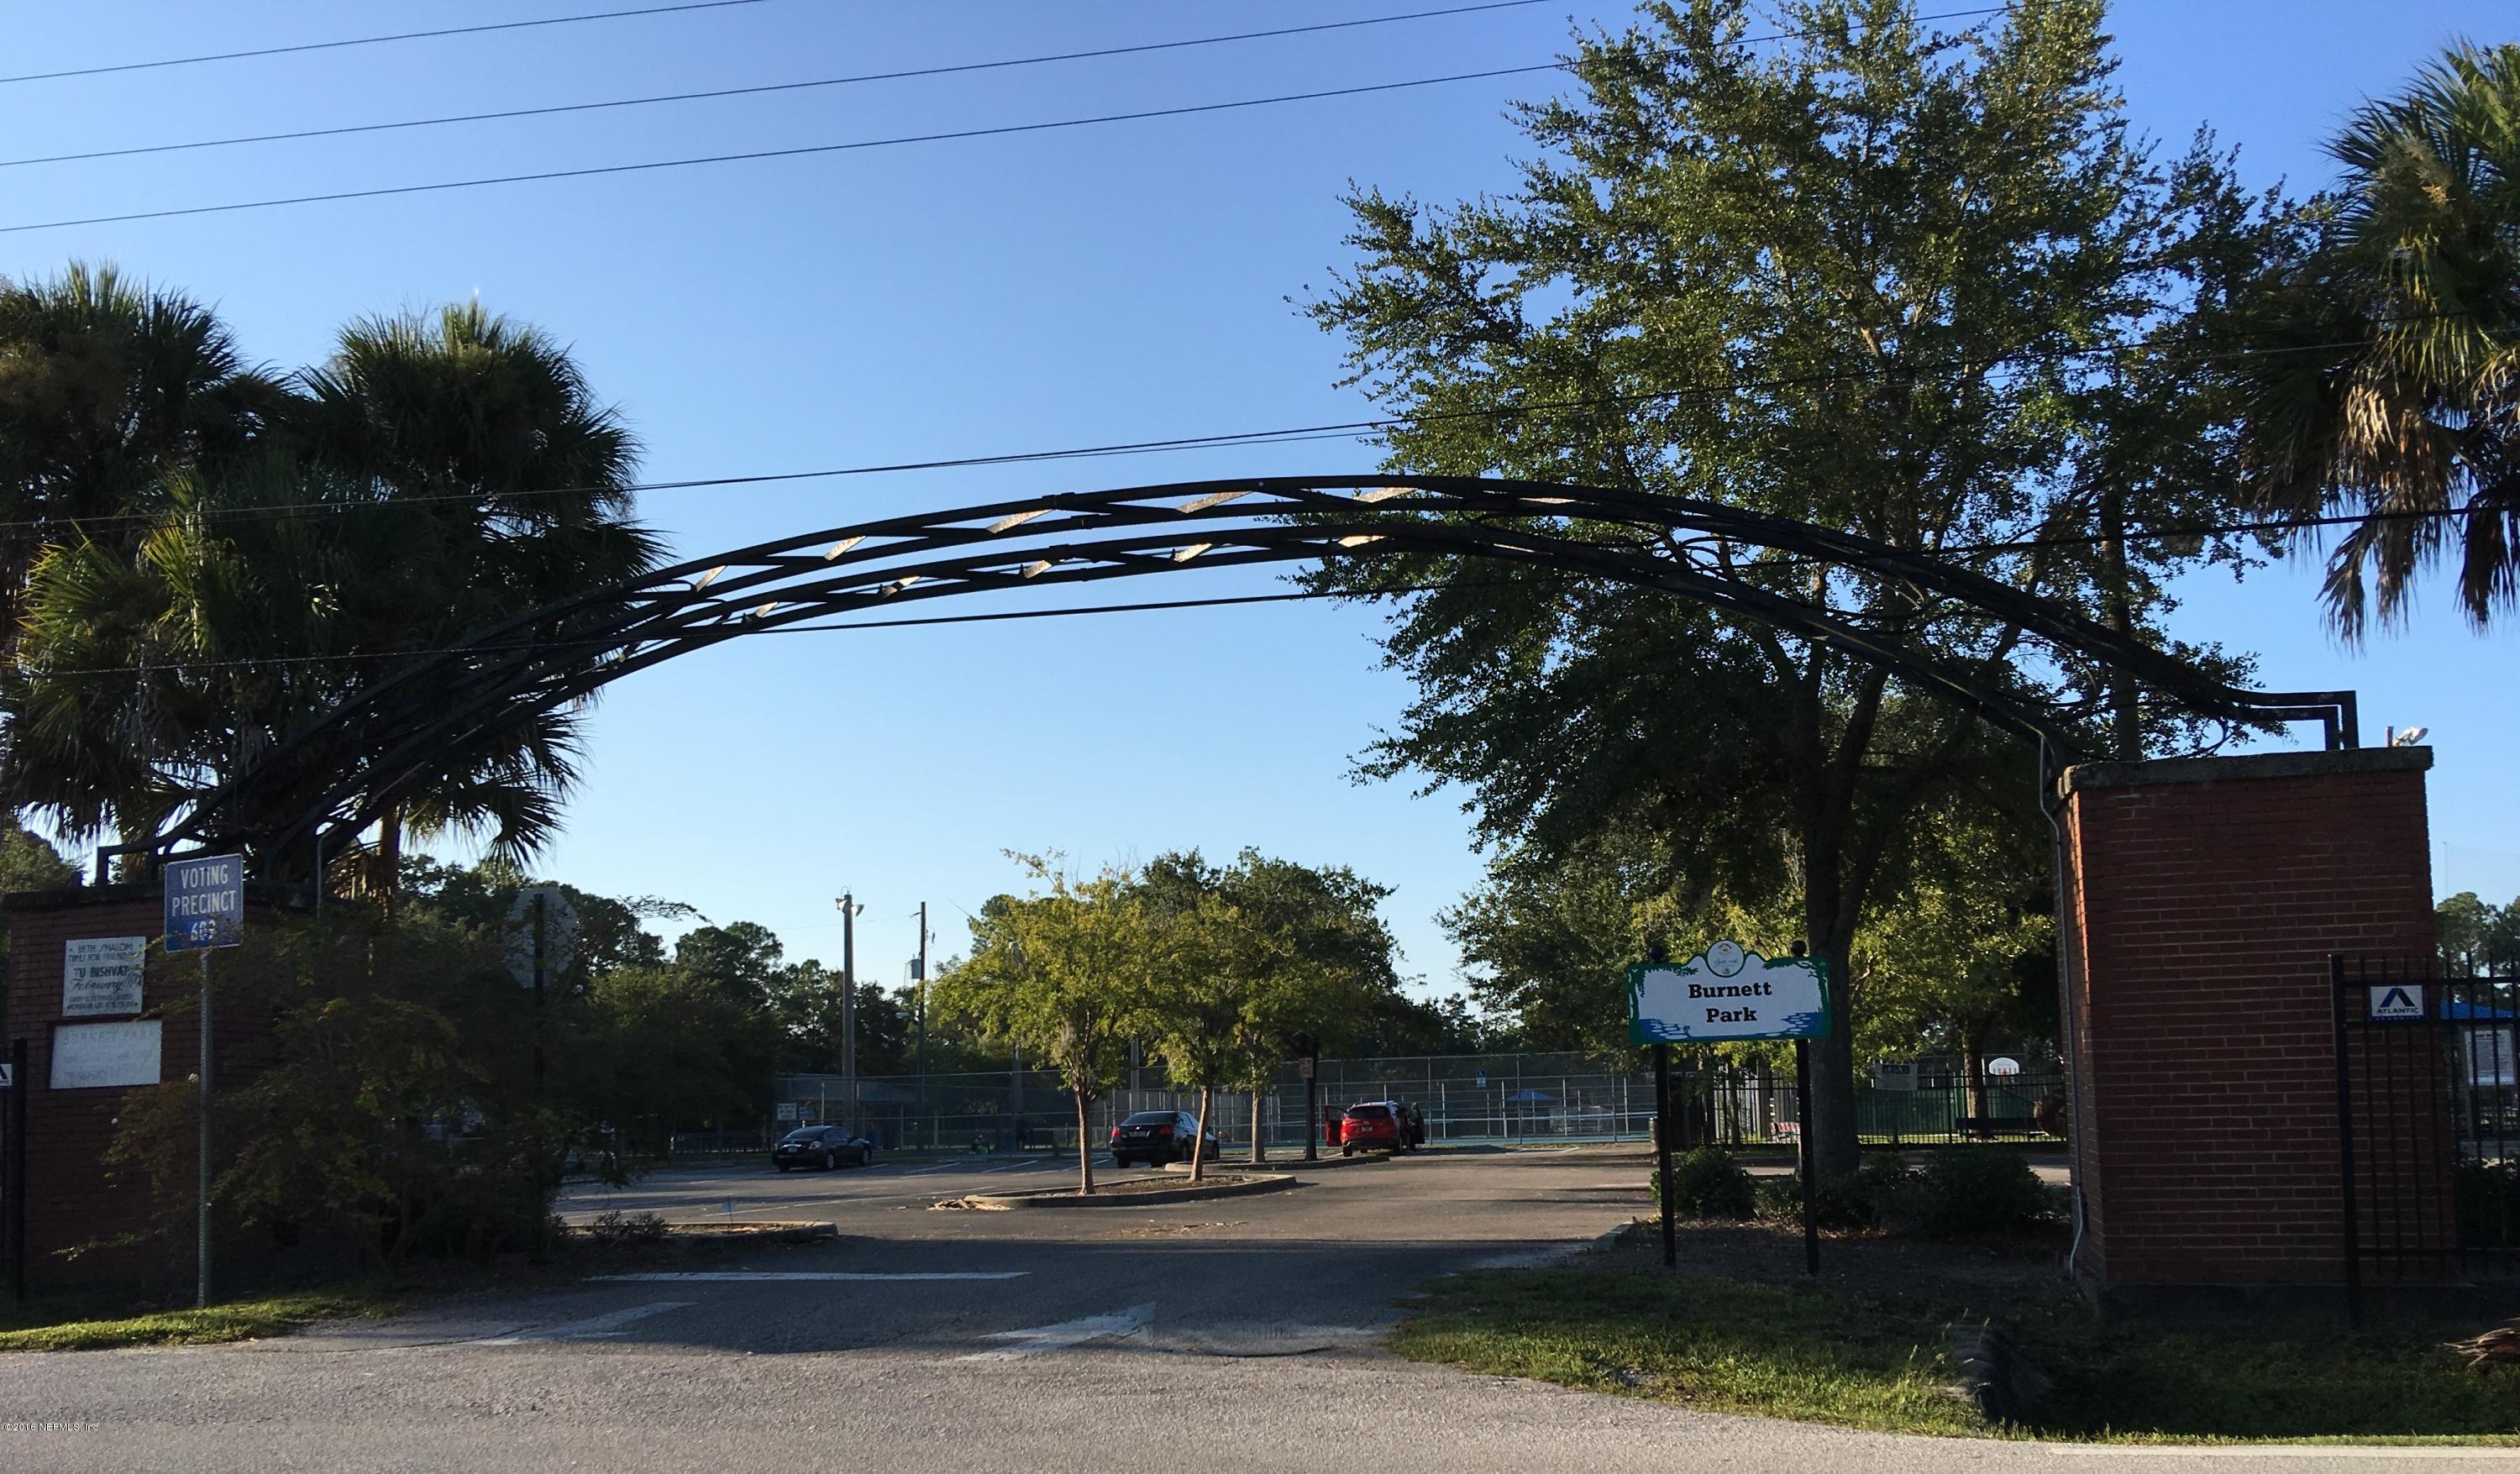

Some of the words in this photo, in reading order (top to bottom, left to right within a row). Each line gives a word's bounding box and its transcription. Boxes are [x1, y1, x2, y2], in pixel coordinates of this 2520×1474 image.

[181, 863, 228, 889] VOTING
[171, 890, 236, 917] PRECINCT
[1688, 981, 1772, 999] Burnett
[1705, 1006, 1758, 1023] Park
